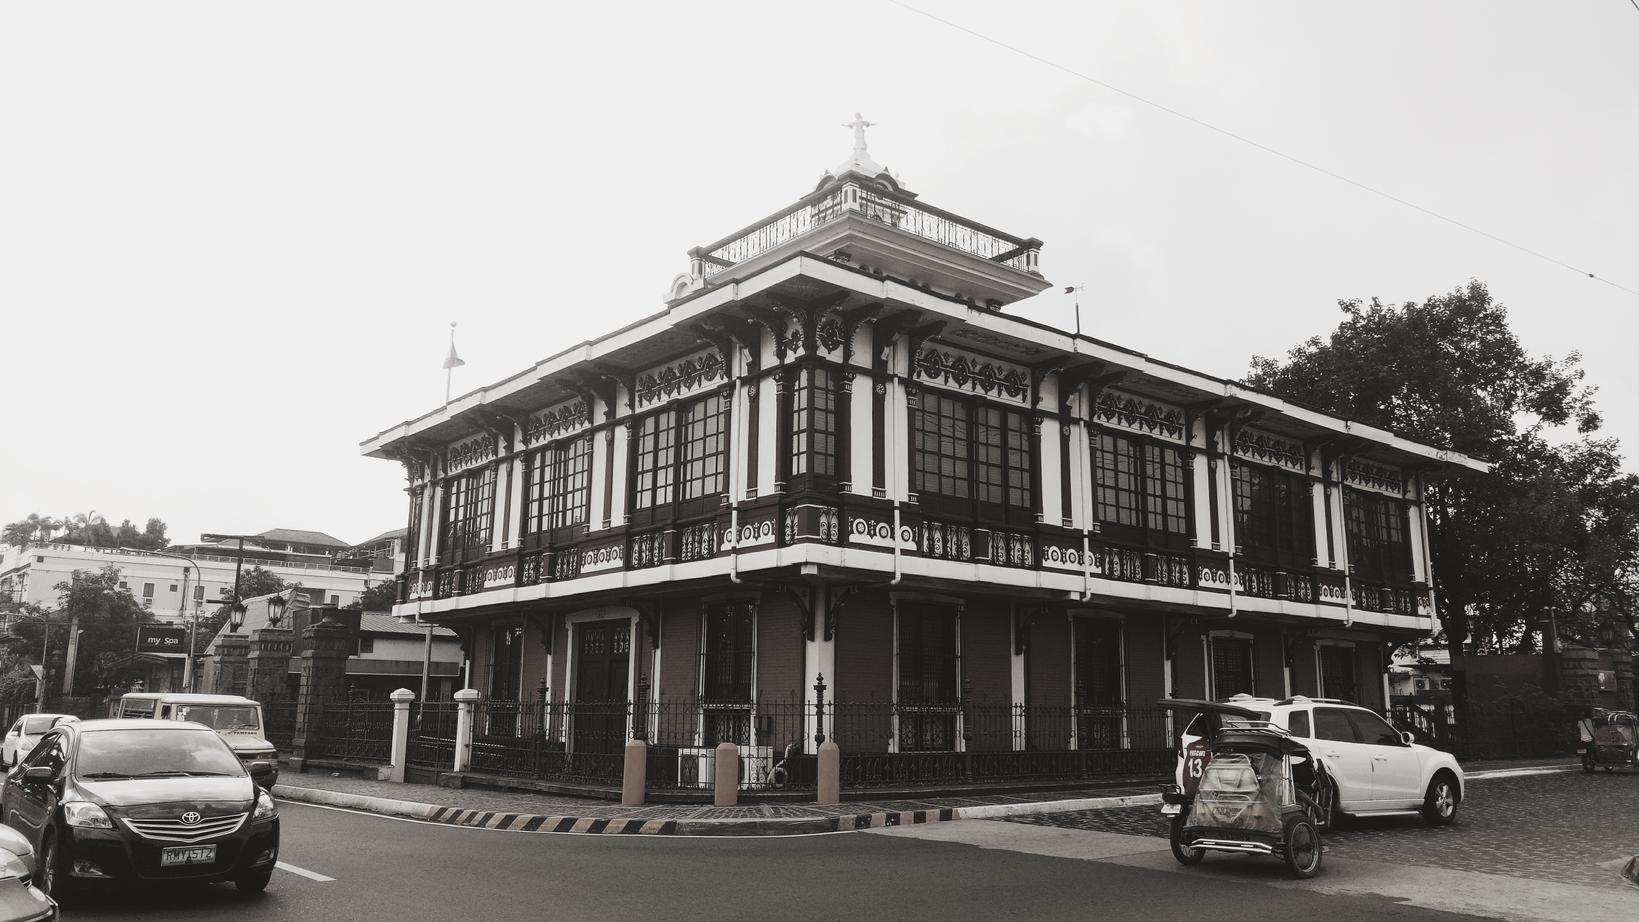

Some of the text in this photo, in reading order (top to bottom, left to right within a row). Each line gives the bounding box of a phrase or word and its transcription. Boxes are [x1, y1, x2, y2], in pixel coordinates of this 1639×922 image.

[147, 637, 179, 646] my Spa
[1188, 758, 1203, 778] 13
